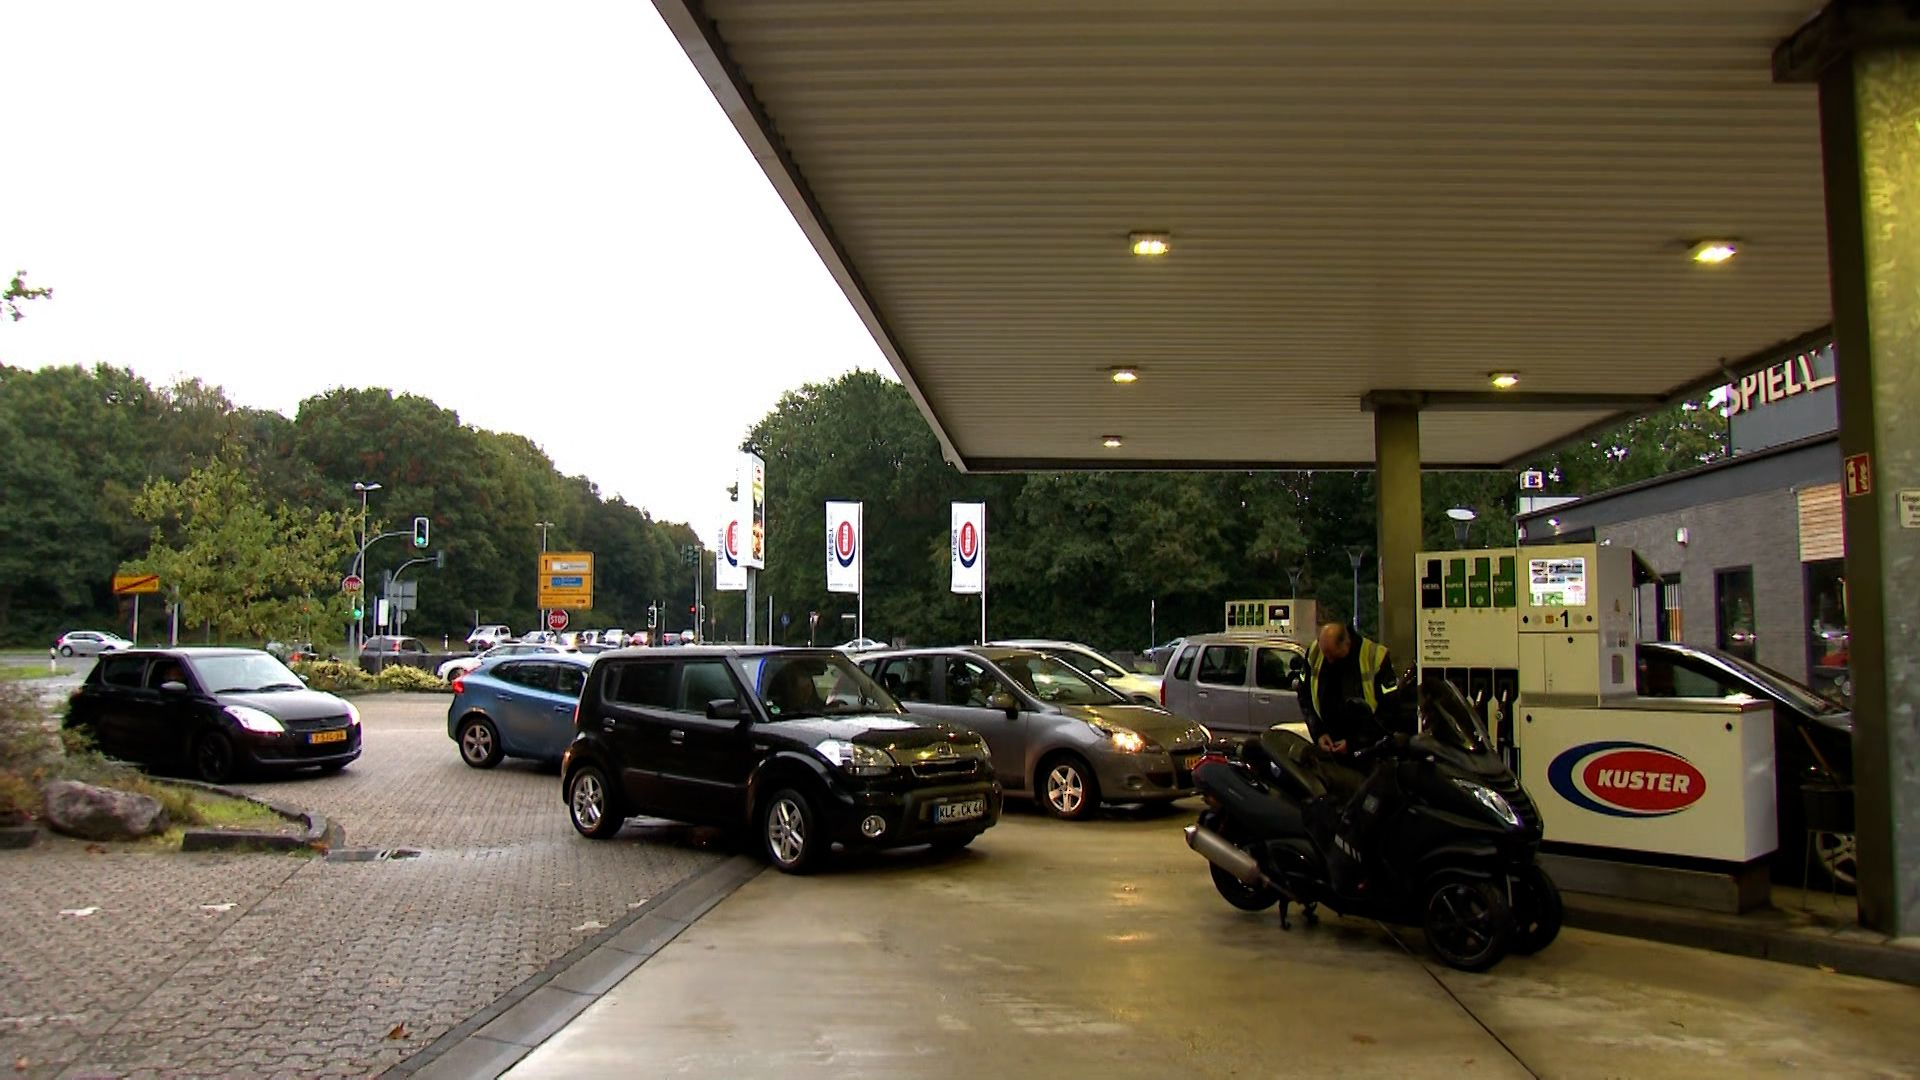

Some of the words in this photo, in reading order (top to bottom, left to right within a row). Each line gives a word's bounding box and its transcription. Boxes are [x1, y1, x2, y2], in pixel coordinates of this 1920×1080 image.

[550, 615, 567, 624] STOP
[1560, 609, 1569, 628] 1
[1597, 769, 1690, 794] KUSTER
